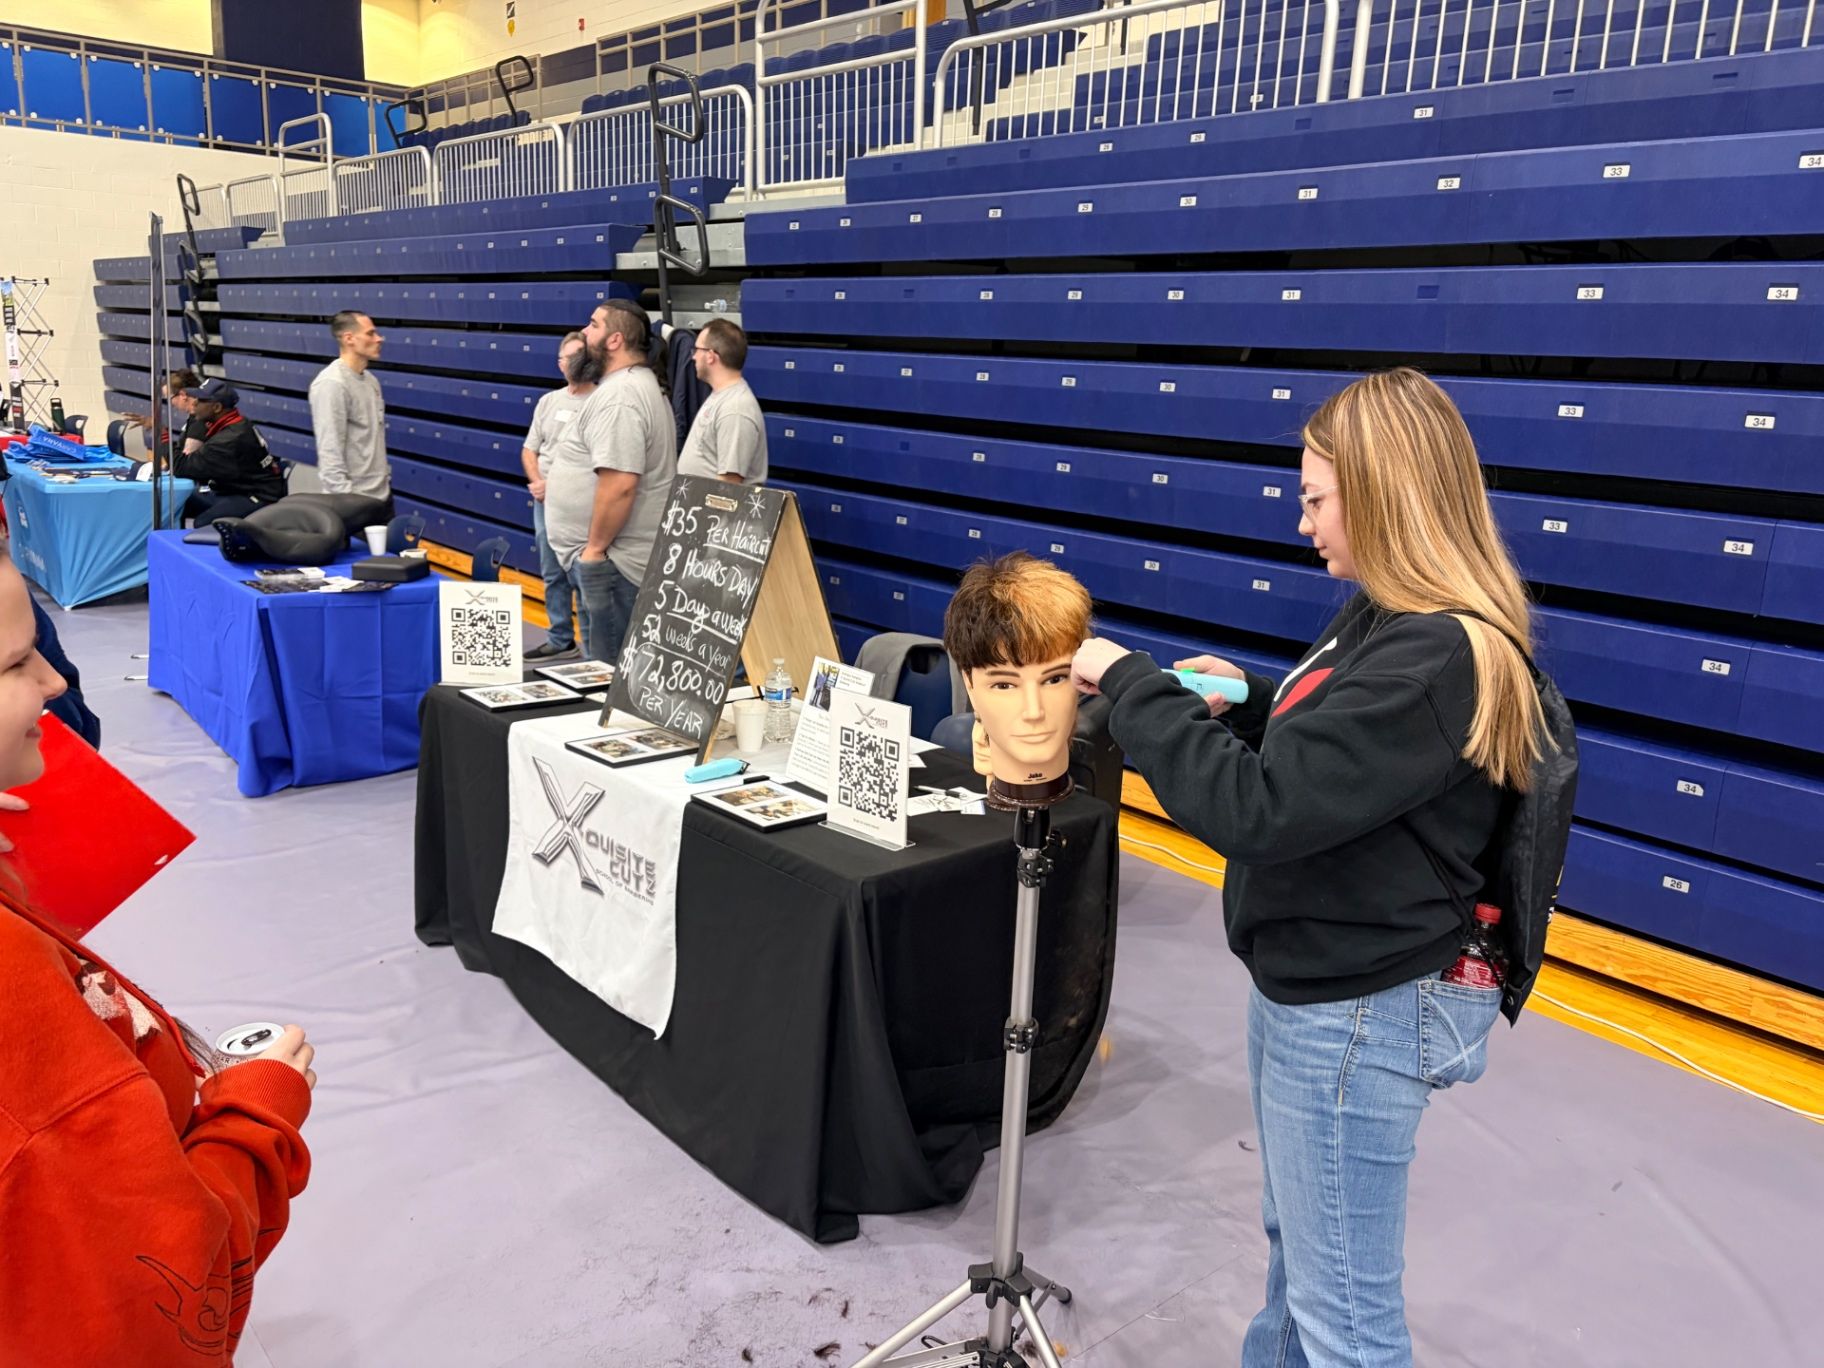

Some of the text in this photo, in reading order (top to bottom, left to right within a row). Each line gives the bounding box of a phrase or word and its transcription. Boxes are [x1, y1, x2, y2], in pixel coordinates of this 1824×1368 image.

[1419, 109, 1428, 117] 31
[1807, 156, 1822, 167] 34
[1610, 166, 1623, 177] 33
[1443, 179, 1454, 188] 32
[1303, 190, 1312, 198] 31
[1286, 291, 1295, 299] 31
[1583, 289, 1596, 299] 33
[1775, 289, 1789, 299] 34
[1276, 390, 1285, 398] 31
[1564, 406, 1577, 416] 33
[1752, 417, 1766, 427] 34
[1267, 487, 1276, 495] 31
[661, 499, 702, 537] $35
[1548, 521, 1561, 531] 33
[1731, 542, 1745, 553] 34
[663, 543, 682, 575] 8
[654, 580, 675, 610] 5
[641, 613, 661, 645] 52
[1708, 662, 1722, 672] 34
[664, 698, 703, 740] YEAR
[1683, 783, 1697, 794] 34
[1670, 879, 1683, 890] 26
